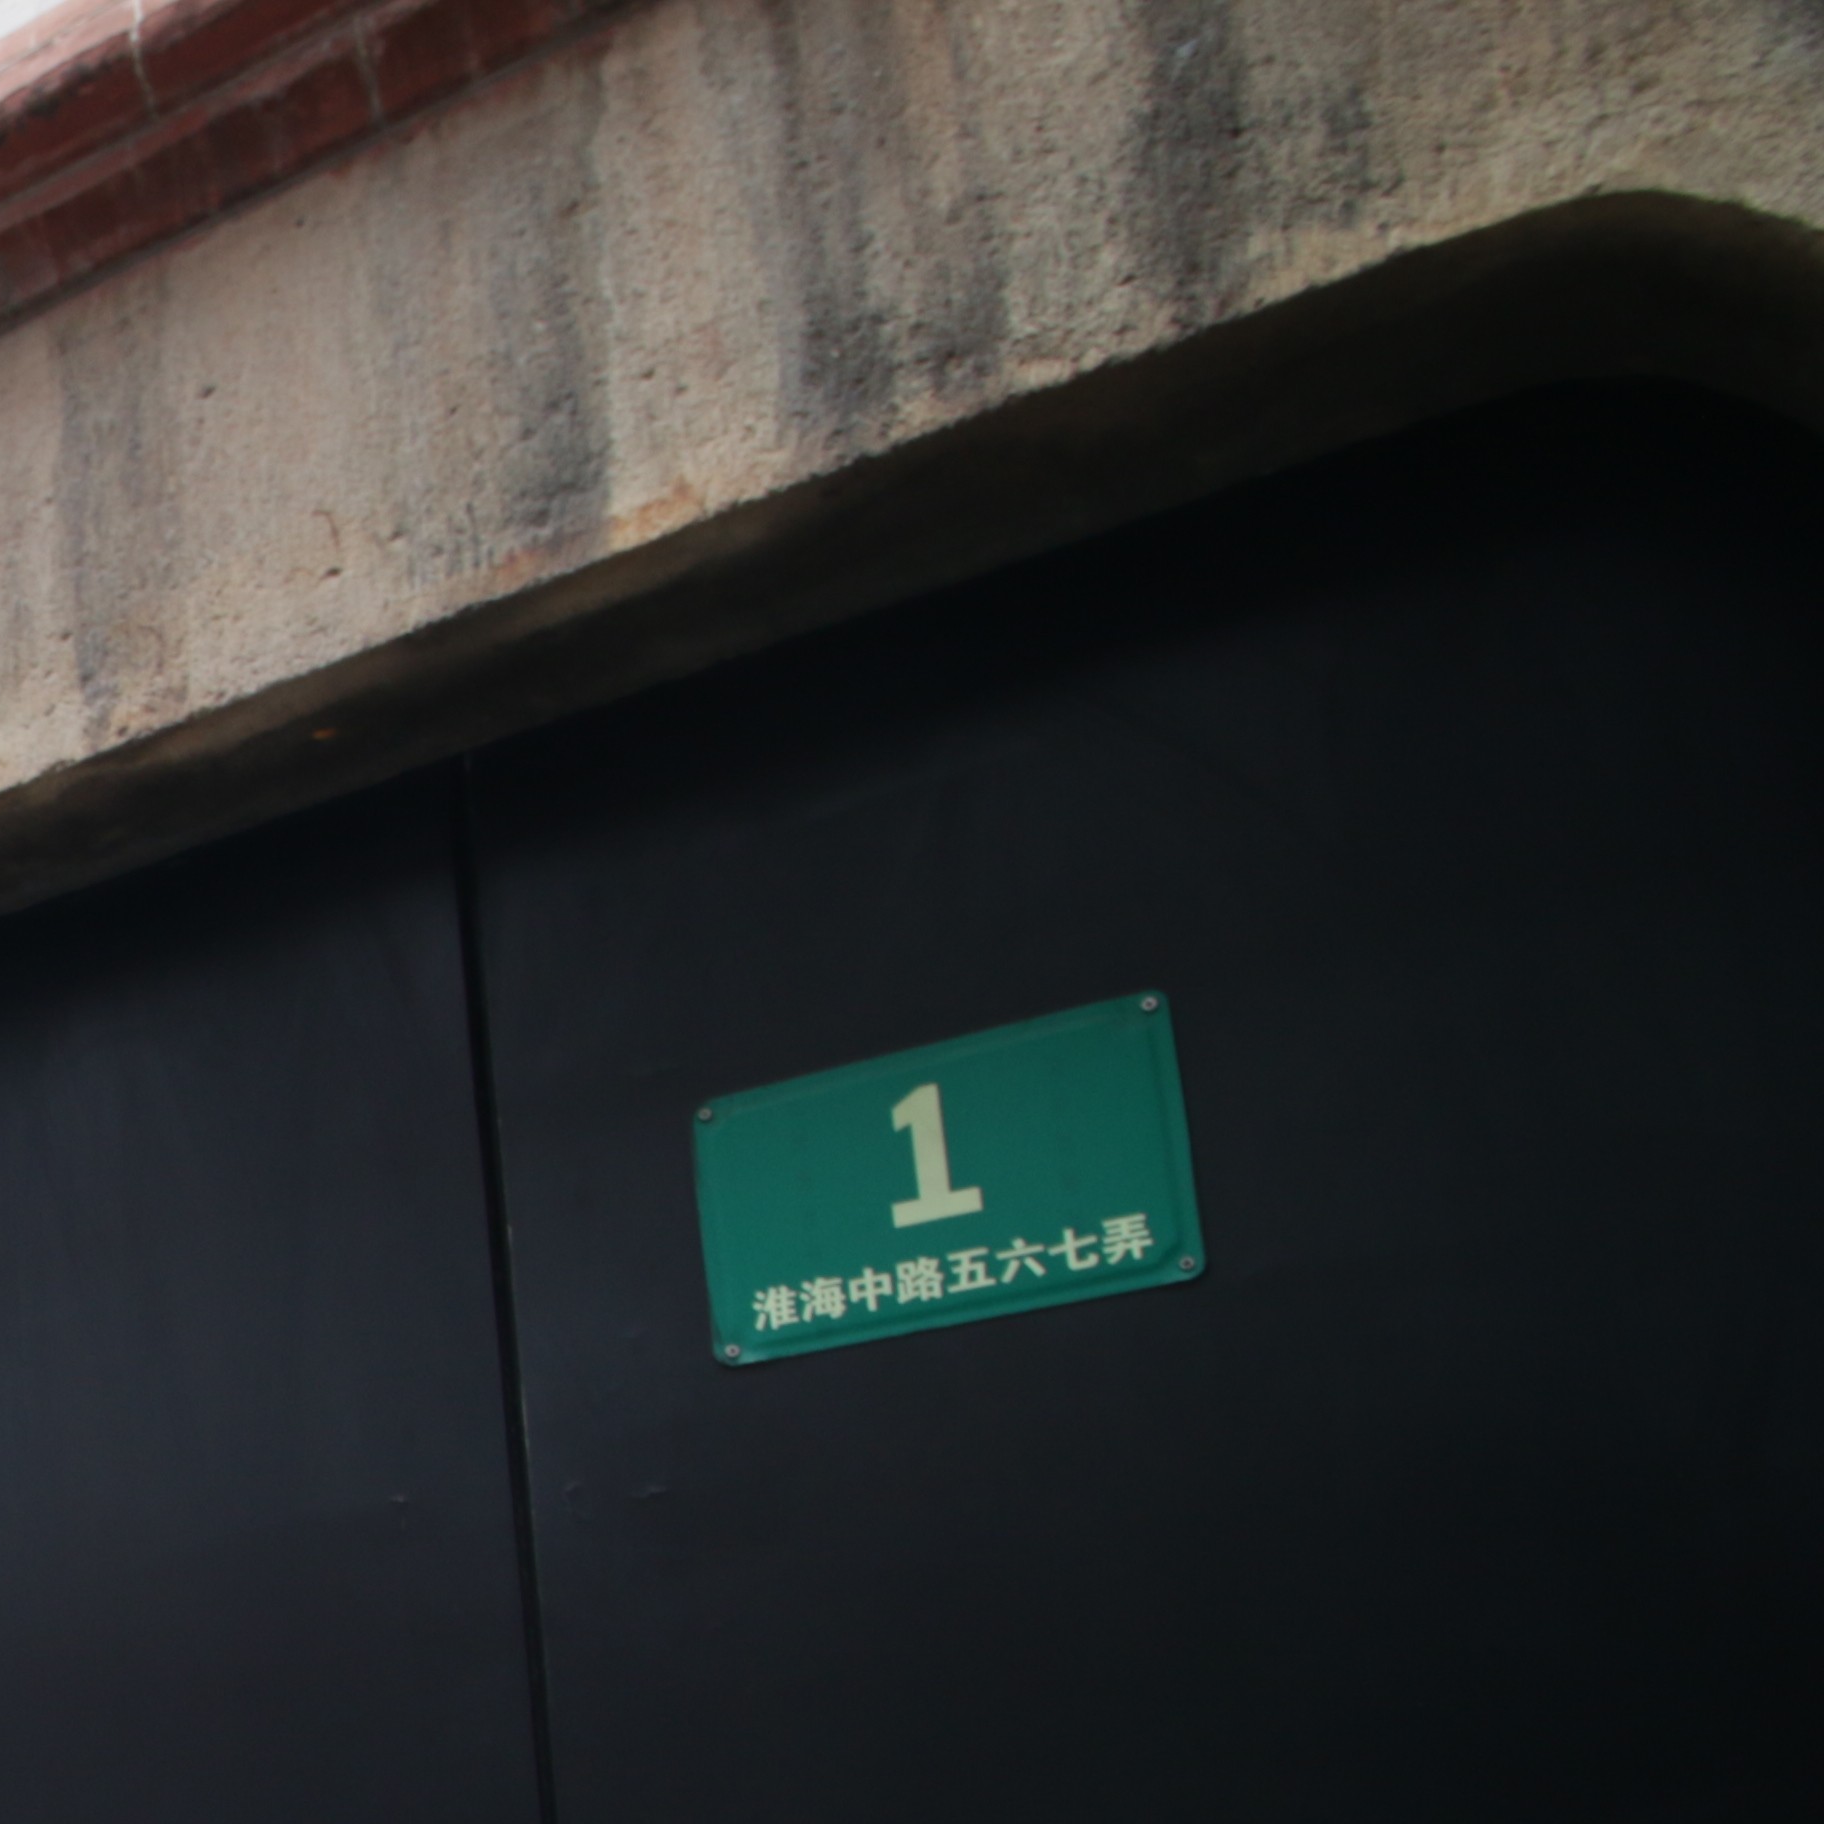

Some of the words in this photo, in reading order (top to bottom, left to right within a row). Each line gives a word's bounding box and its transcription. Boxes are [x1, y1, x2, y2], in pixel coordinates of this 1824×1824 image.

[891, 1083, 983, 1229] 1
[752, 1213, 1154, 1331] 淮海中路五六七弄
